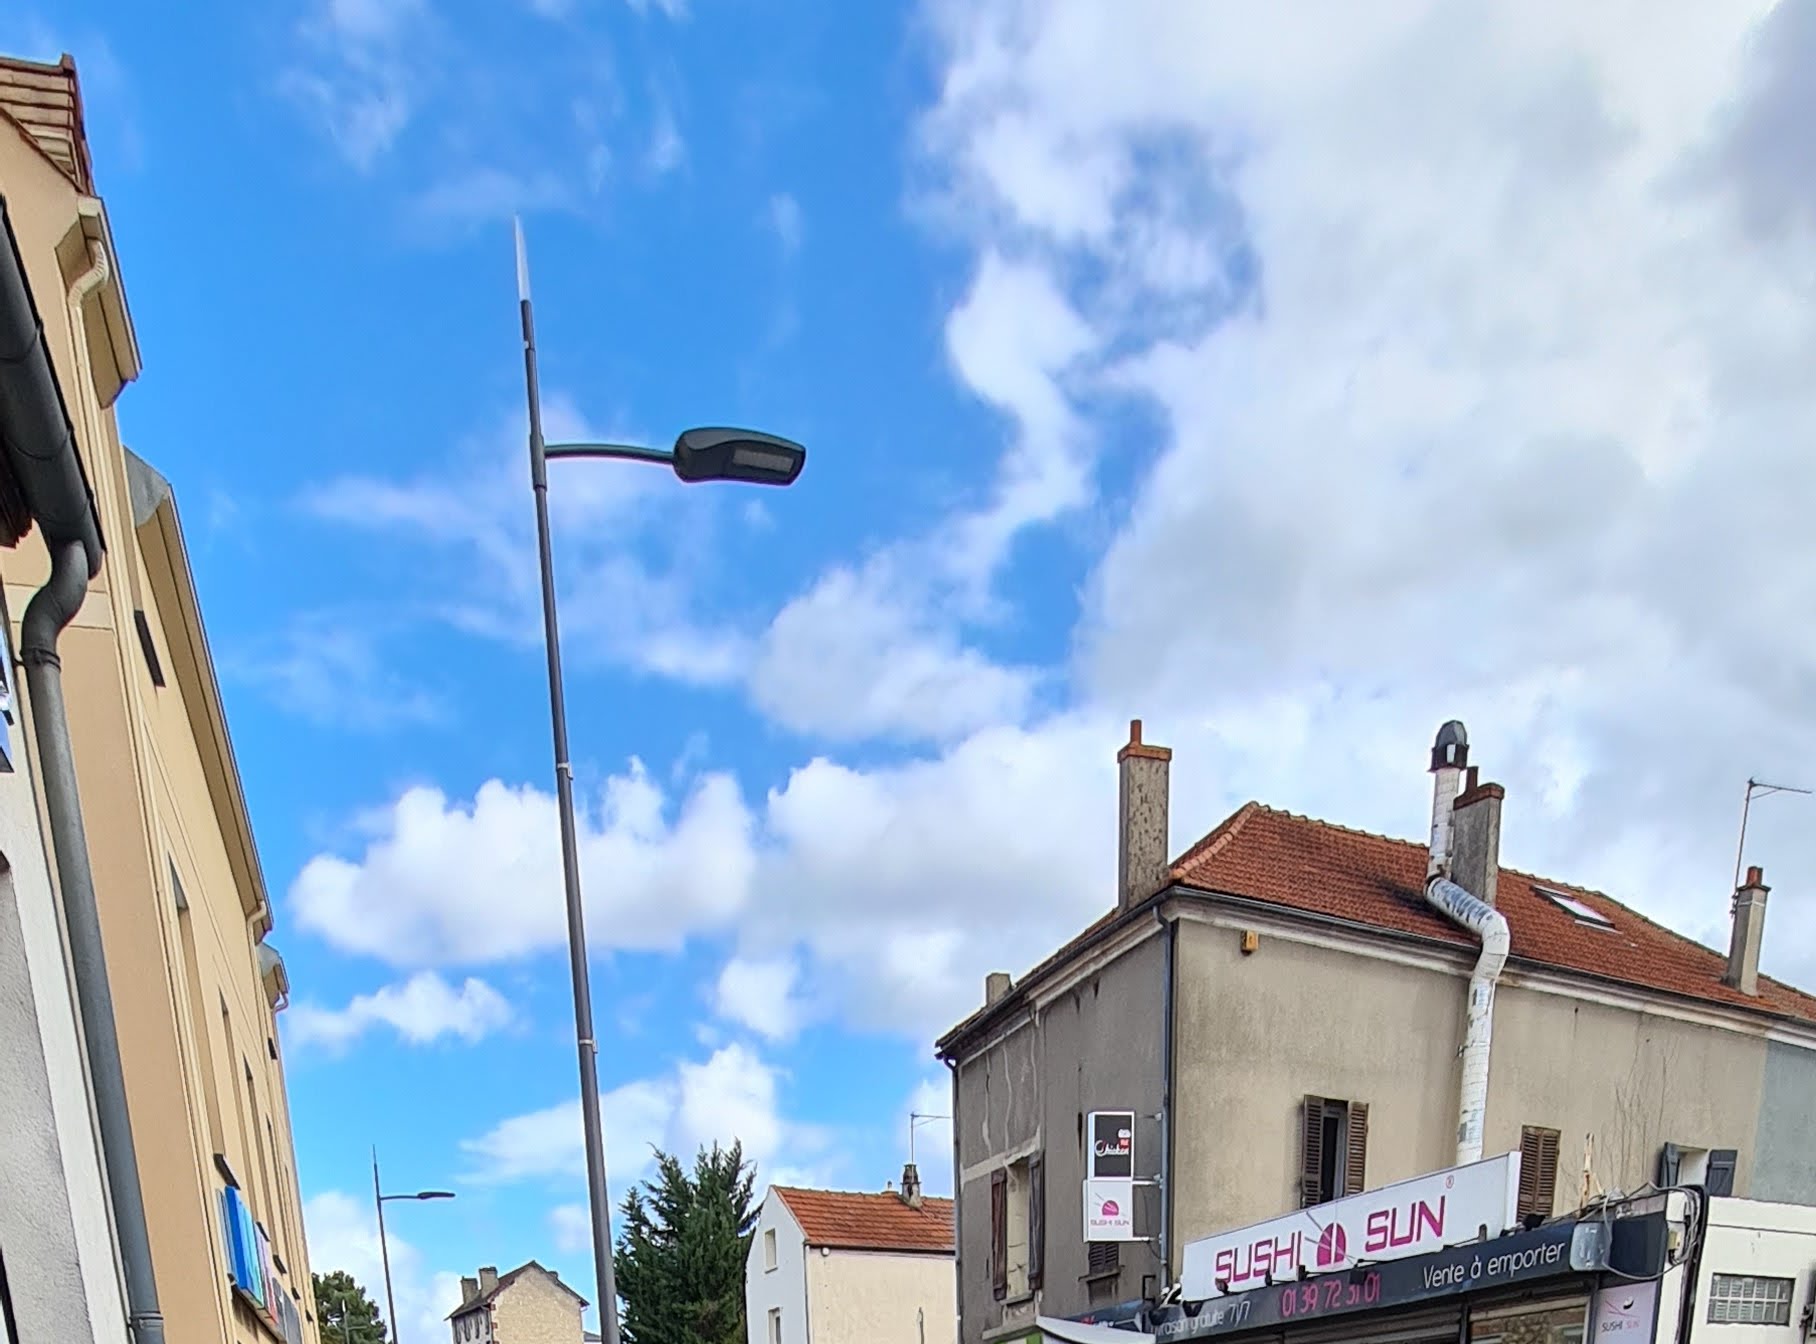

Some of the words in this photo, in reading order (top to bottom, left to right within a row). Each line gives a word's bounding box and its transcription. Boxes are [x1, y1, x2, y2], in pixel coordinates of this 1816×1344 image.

[1215, 1231, 1302, 1284] SUSHI
[1365, 1195, 1446, 1253] SUN
[1423, 1264, 1465, 1289] Vente
[1470, 1254, 1482, 1279] à
[1487, 1242, 1565, 1278] emporter
[1282, 1286, 1297, 1317] 01
[1300, 1283, 1319, 1314] 39
[1324, 1279, 1342, 1309] 72
[1364, 1273, 1381, 1303] 01
